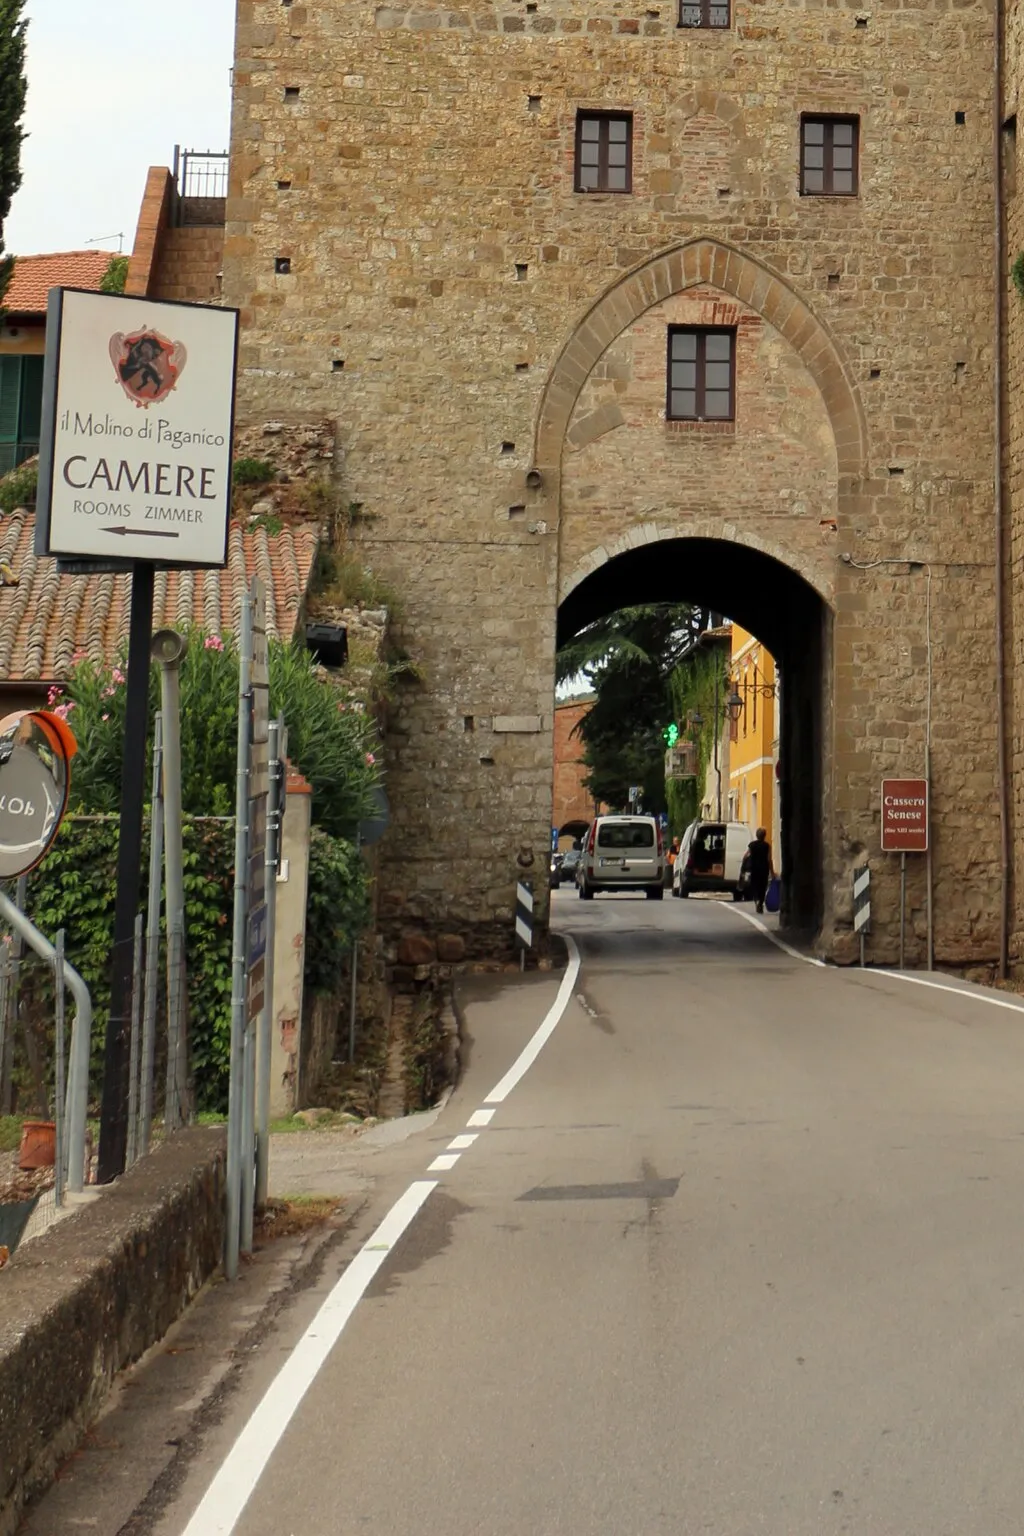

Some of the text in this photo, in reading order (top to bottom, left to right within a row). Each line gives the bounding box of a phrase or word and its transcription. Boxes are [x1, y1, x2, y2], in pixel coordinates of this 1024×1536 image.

[61, 410, 225, 449] il Molino di Paganico
[63, 455, 217, 500] CAMERE
[73, 500, 203, 523] ROOMS ZIMMER
[884, 796, 925, 806] Cassero
[887, 809, 921, 820] Senese
